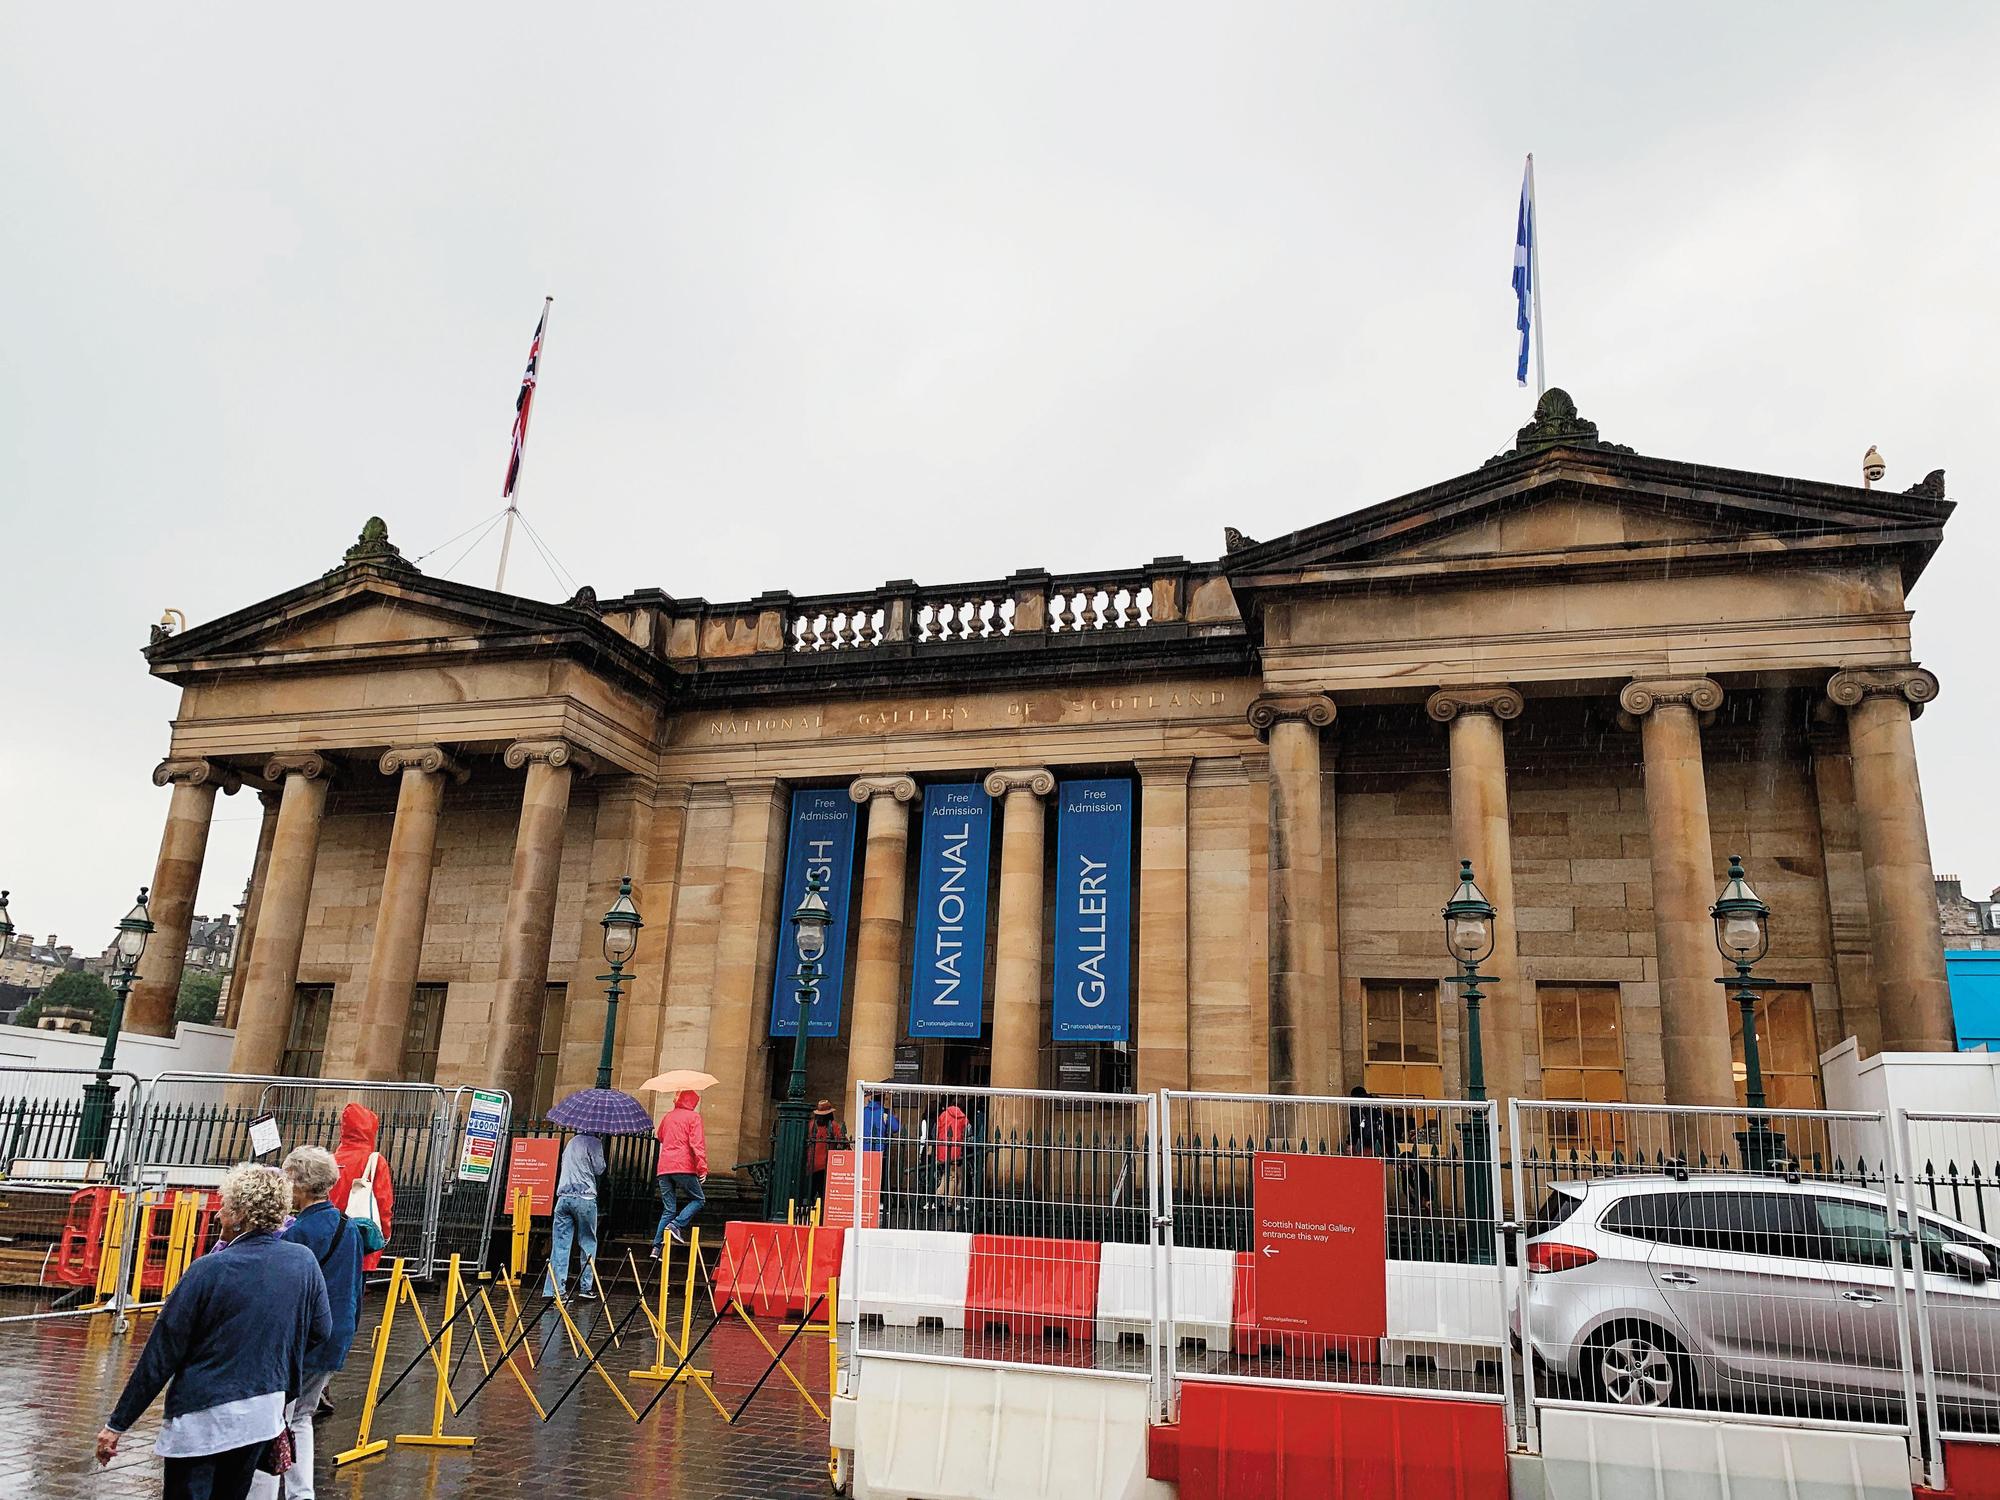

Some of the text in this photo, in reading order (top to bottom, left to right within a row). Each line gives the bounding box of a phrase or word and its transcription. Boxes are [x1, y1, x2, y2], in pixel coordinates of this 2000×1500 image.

[710, 690, 1226, 736] NATIONAL GALLERY OF SCOTLAND
[947, 793, 969, 803] Free
[1084, 790, 1107, 800] Free
[815, 799, 836, 808] Free
[1068, 801, 1122, 813] Admission
[800, 811, 848, 821] Admission
[932, 806, 983, 816] Admission
[933, 823, 969, 1006] NATIONAL
[1077, 854, 1107, 1008] GALLERY
[925, 1020, 974, 1028] nationalgalleries.org
[1070, 1023, 1121, 1031] nationalgalleries.org
[1262, 1219, 1356, 1234] Scottish National Gallery
[1262, 1231, 1329, 1243] entrance this way
